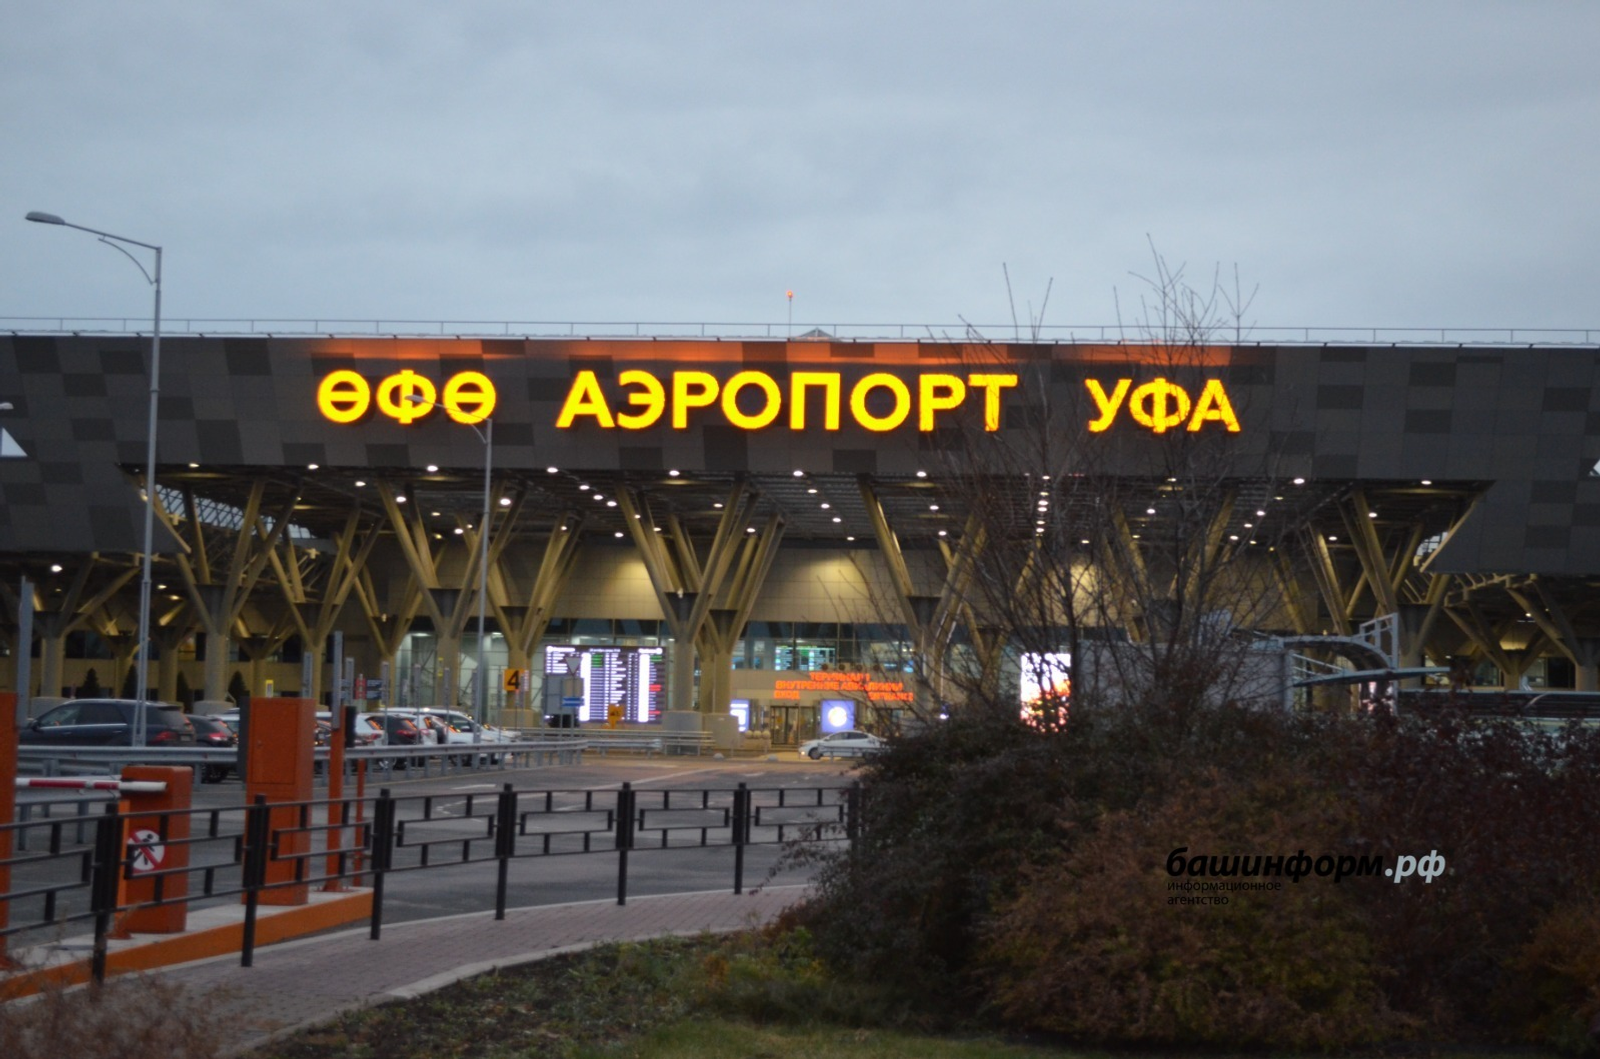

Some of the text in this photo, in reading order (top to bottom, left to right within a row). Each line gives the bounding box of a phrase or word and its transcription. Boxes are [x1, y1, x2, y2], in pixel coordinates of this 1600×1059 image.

[317, 369, 1241, 433] ӨФӨ АЭРОПОРТ УФА
[507, 670, 520, 690] 4
[775, 680, 840, 690] ВНУТРЕННИЕ
[773, 689, 800, 700] ВХОД
